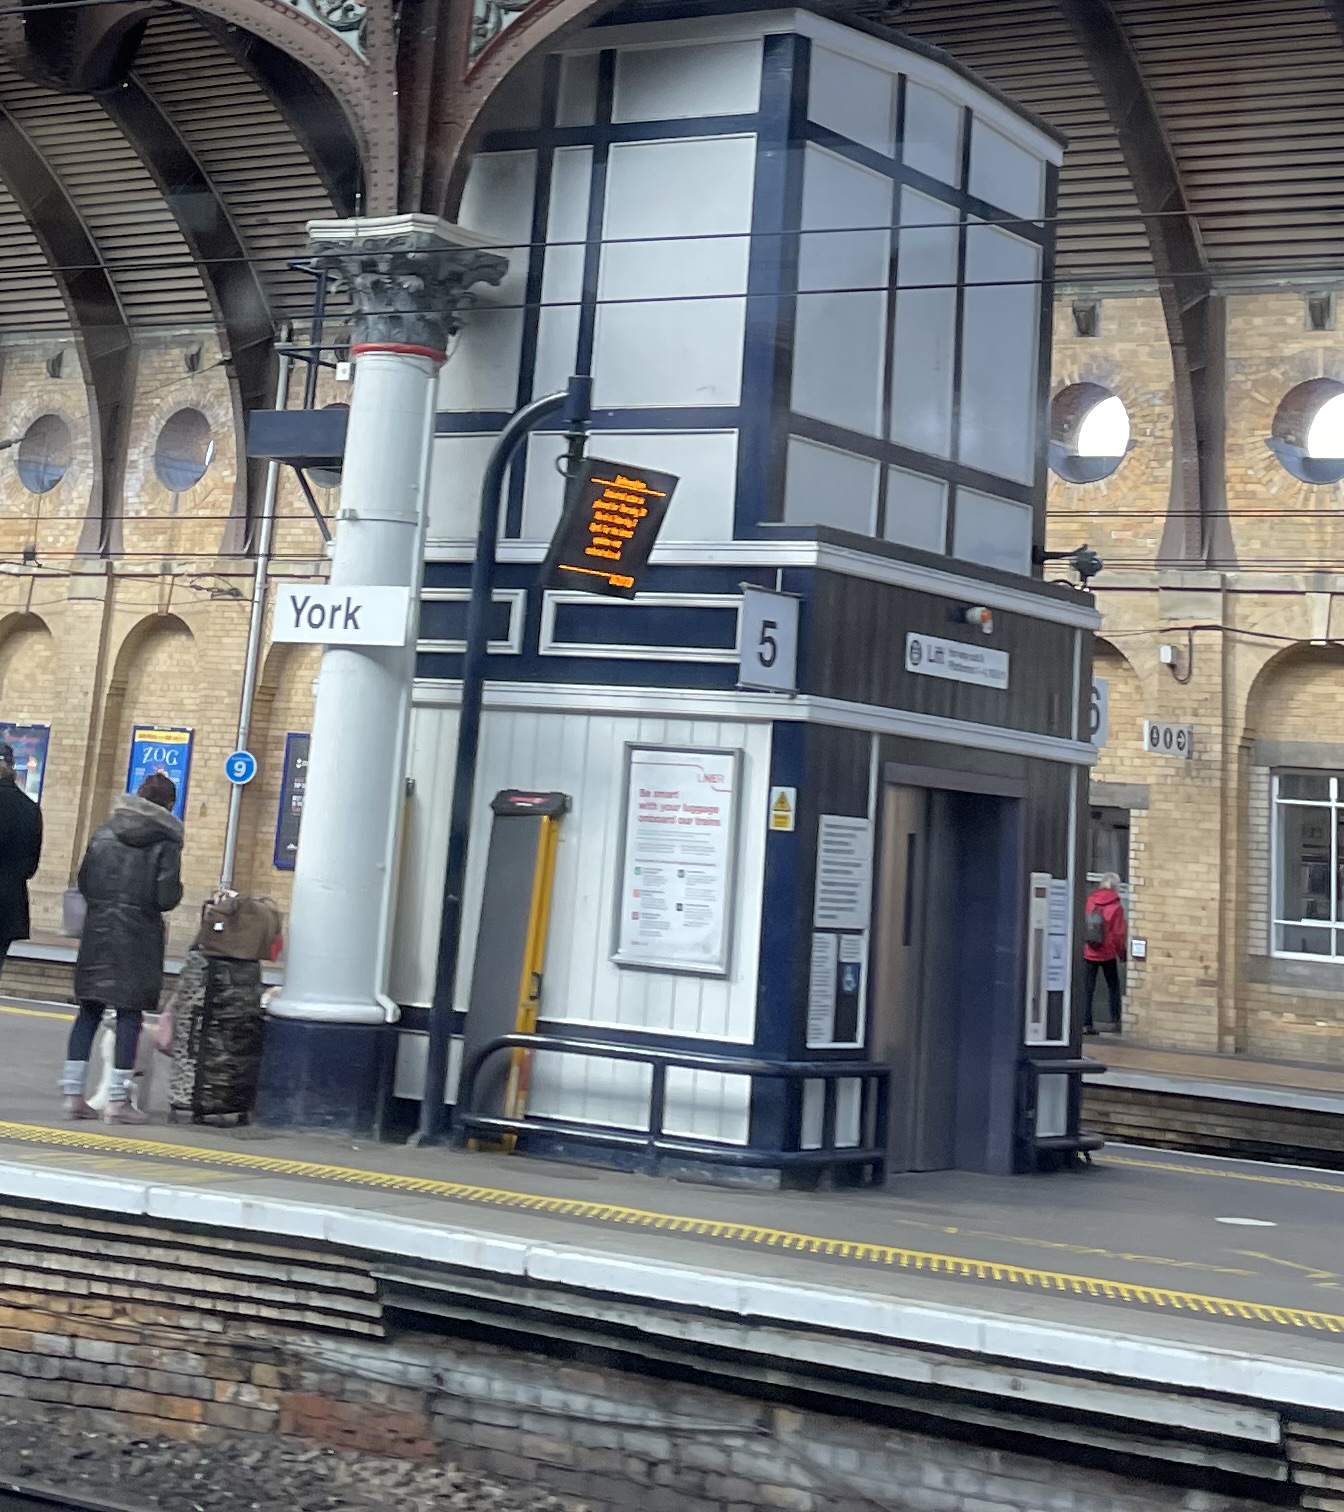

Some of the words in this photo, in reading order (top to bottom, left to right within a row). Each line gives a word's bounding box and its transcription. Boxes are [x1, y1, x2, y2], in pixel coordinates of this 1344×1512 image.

[290, 594, 363, 630] York
[757, 620, 777, 668] 5
[142, 746, 179, 766] ZOG
[233, 760, 247, 778] 9
